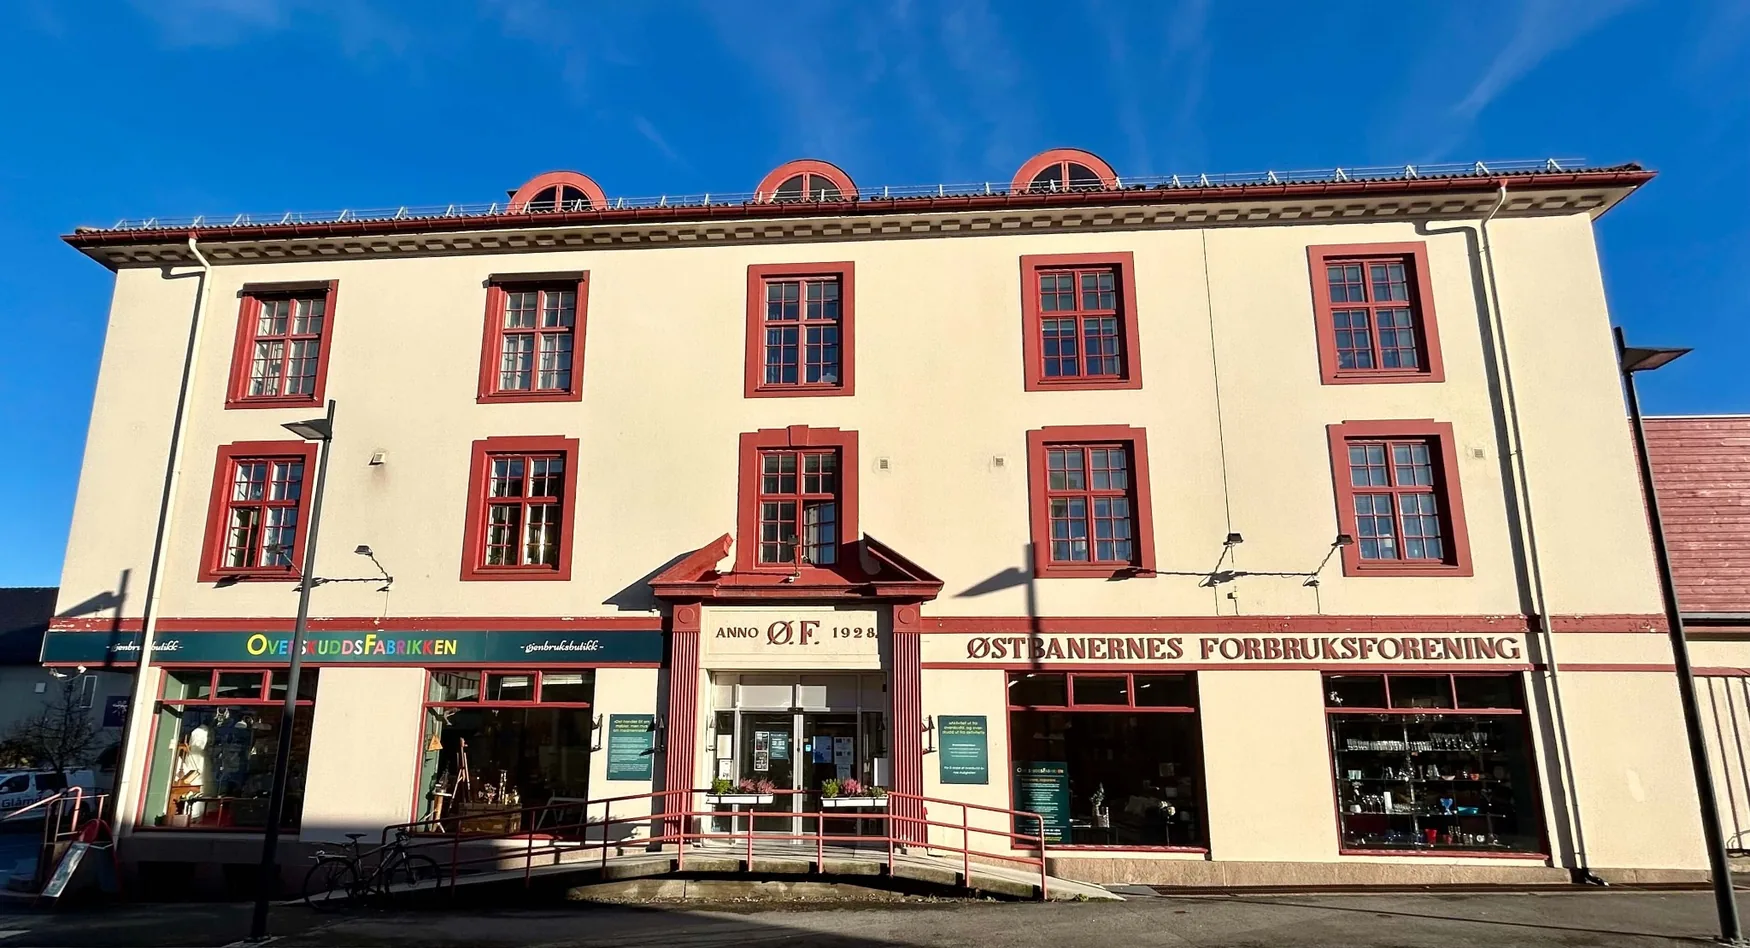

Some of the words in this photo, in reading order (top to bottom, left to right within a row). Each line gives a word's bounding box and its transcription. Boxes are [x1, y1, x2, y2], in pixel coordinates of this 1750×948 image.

[715, 626, 760, 639] ANNO
[966, 636, 1184, 660] ØSTBANERNES
[1199, 636, 1522, 660] FORBRUKSFORENING
